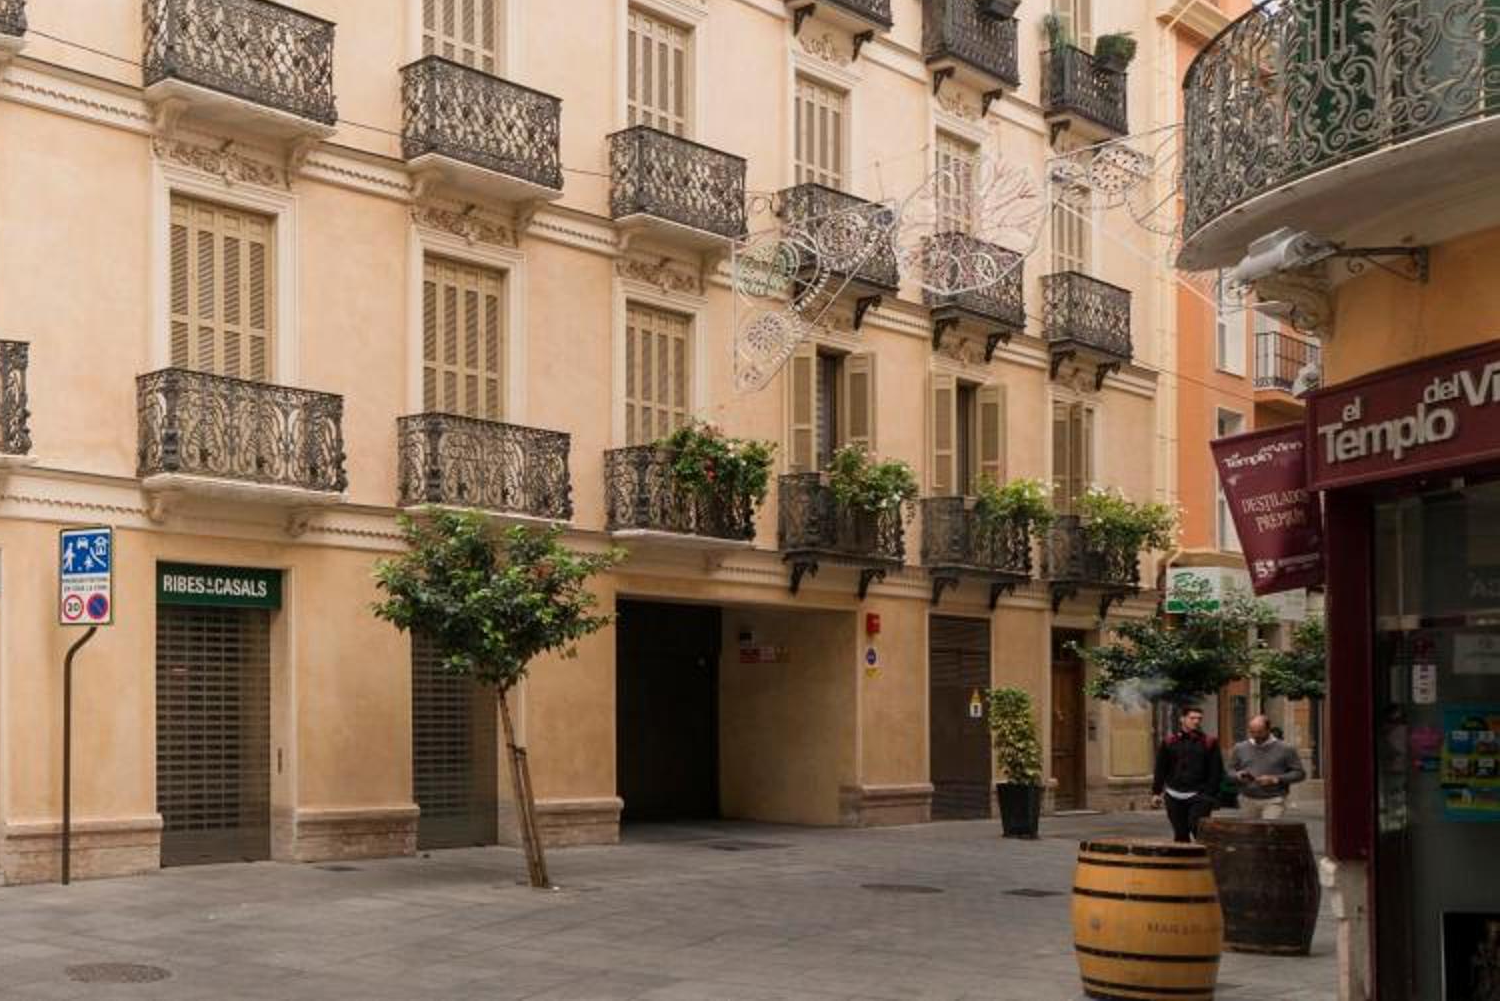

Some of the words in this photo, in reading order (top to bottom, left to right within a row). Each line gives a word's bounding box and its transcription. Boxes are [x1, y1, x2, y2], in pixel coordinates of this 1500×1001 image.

[1342, 396, 1361, 422] el
[1318, 402, 1456, 464] Templo
[163, 574, 204, 594] RIBES
[214, 577, 268, 598] CASALS
